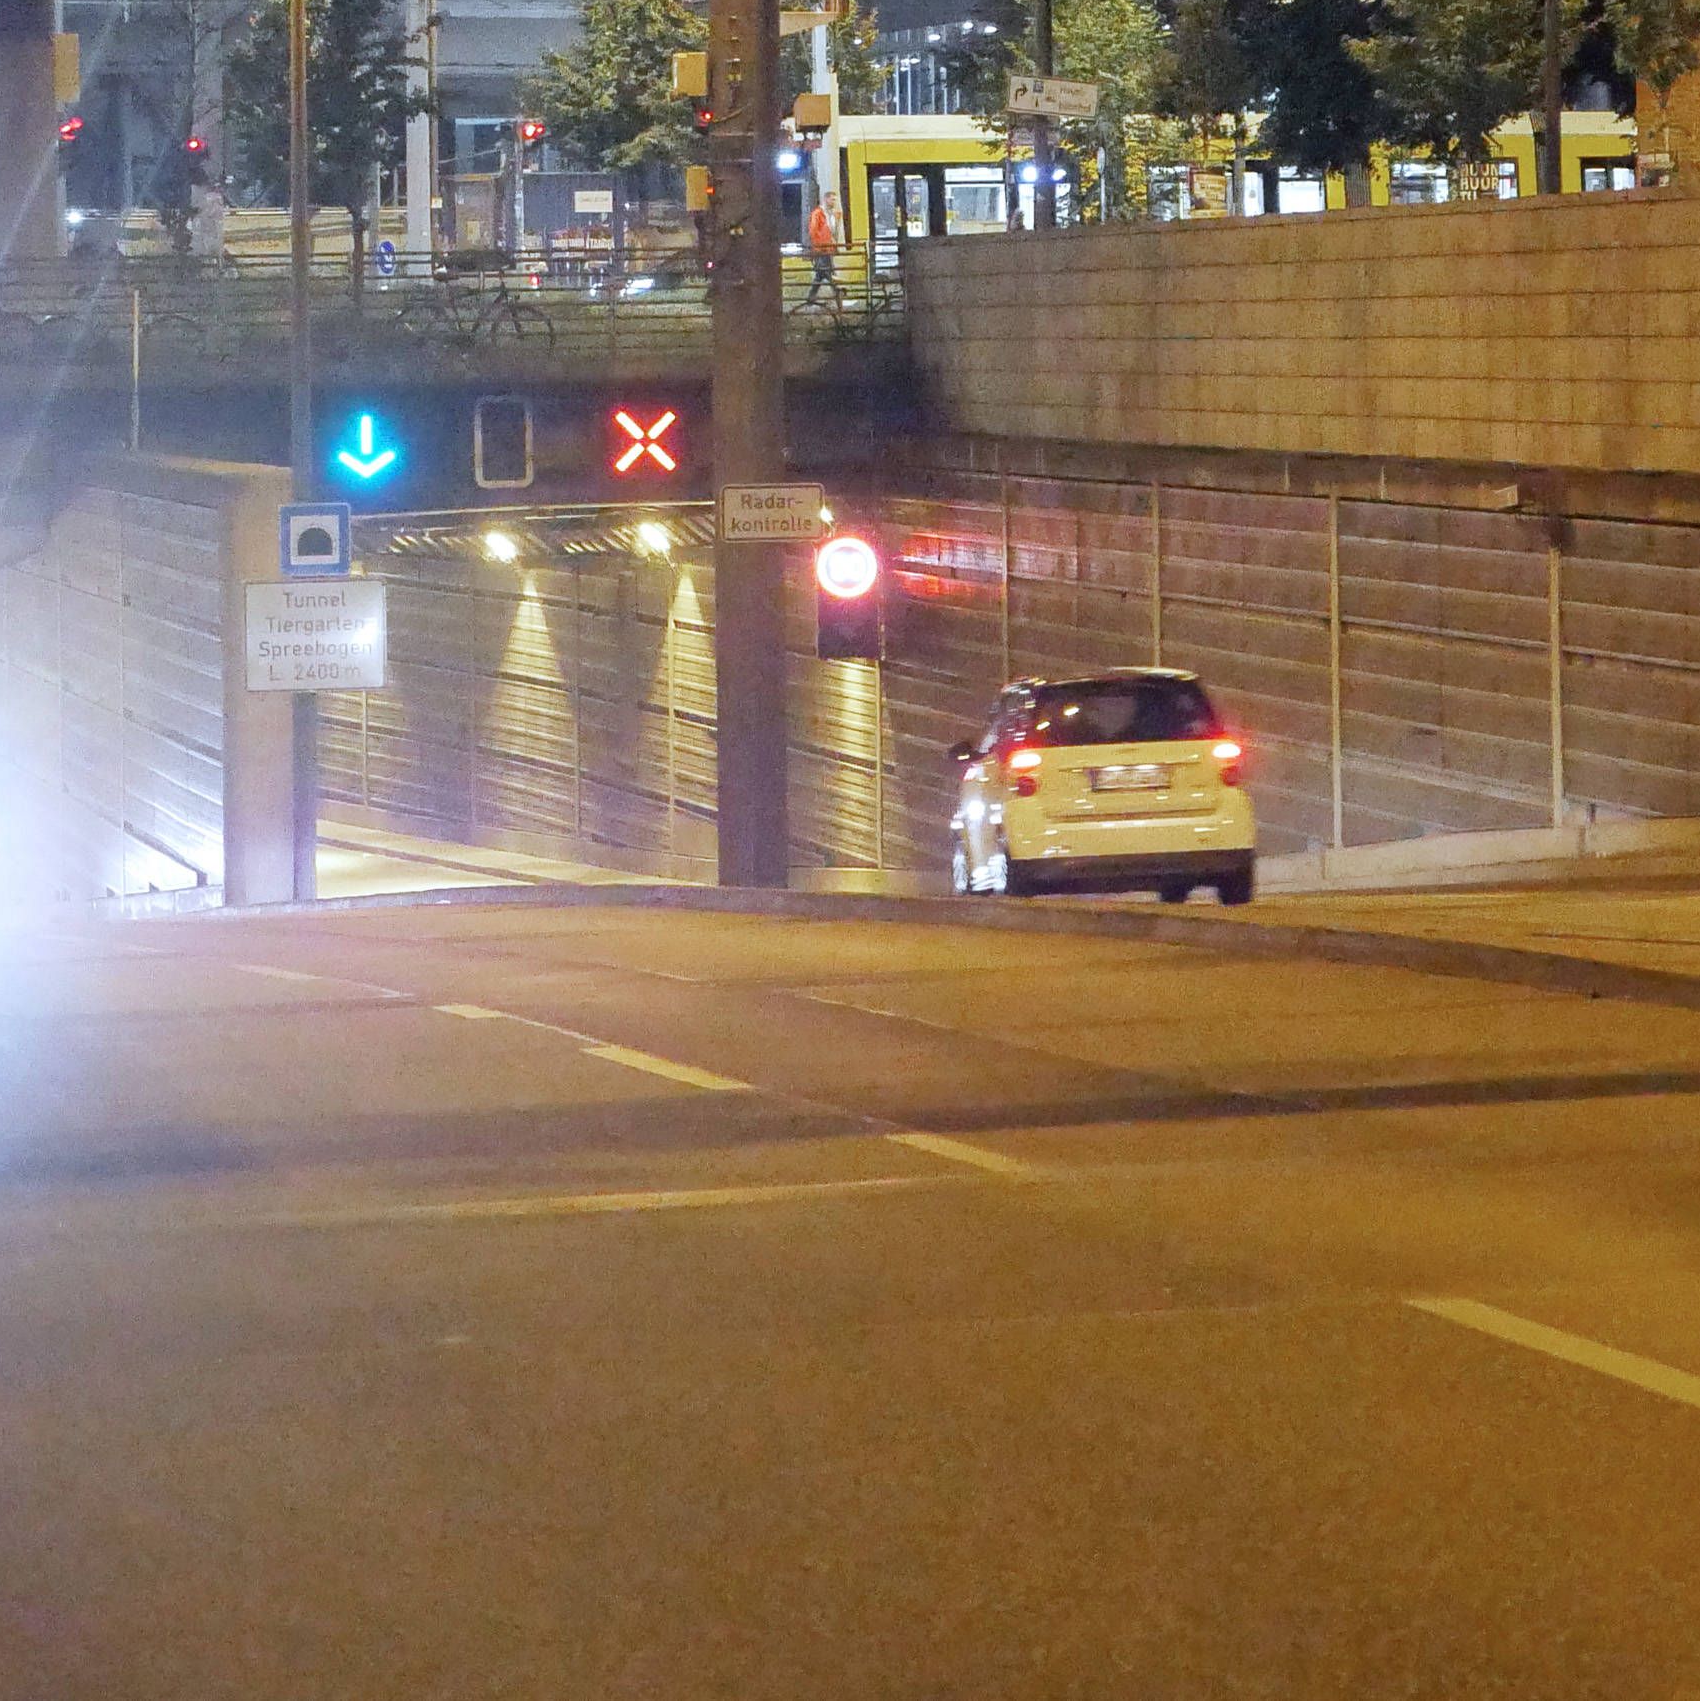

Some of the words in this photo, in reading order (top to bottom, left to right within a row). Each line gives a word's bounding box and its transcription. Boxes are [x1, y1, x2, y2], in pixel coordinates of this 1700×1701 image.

[741, 493, 803, 510] Radar-
[731, 514, 812, 533] kontrolle
[283, 590, 347, 608] Tunnel
[258, 640, 372, 659] Spreebogen
